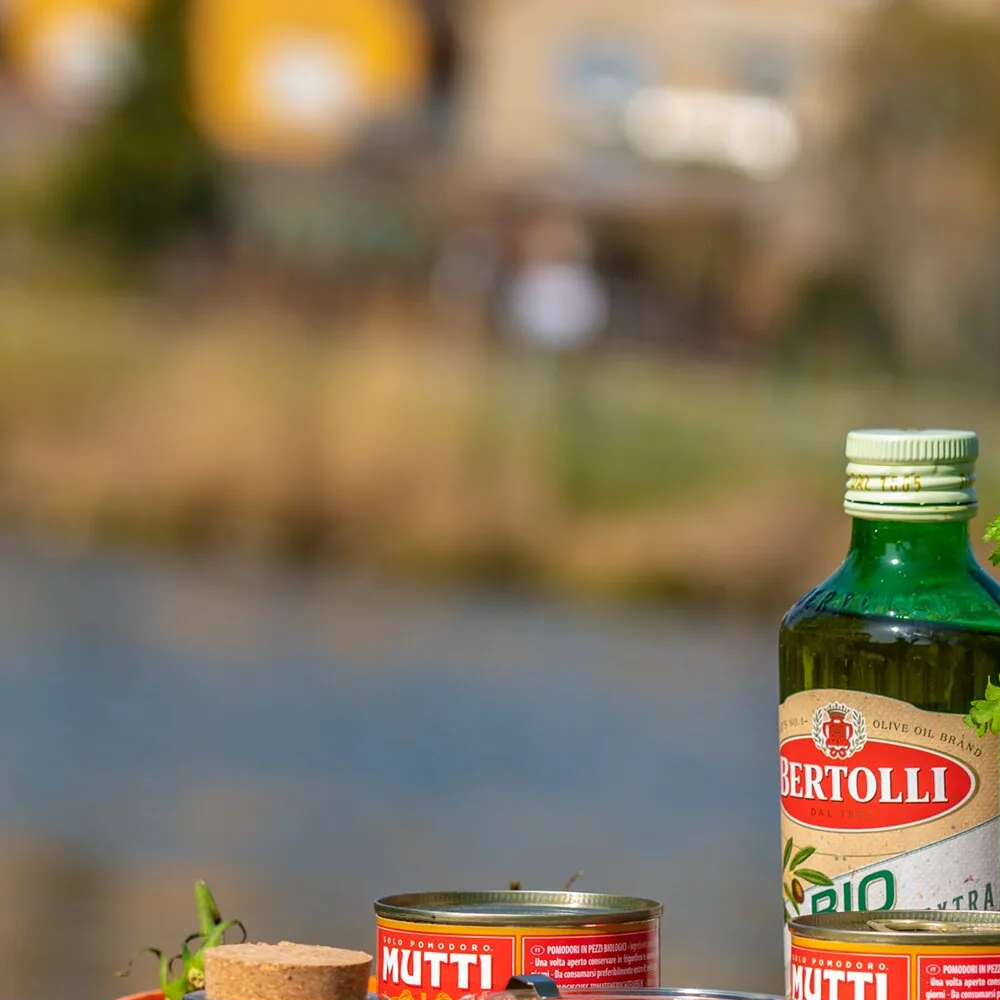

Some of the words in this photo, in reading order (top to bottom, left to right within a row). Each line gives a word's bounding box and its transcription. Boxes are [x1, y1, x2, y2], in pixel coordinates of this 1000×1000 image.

[873, 719, 908, 733] OLIVE
[914, 726, 934, 738] OIL
[940, 732, 983, 758] BRAND
[780, 756, 948, 804] BERTOLLI
[925, 883, 994, 911] TRA
[383, 936, 402, 945] SOLO
[547, 945, 580, 954] POMODORI
[581, 945, 587, 953] IN
[588, 945, 603, 953] PEZZI
[535, 958, 548, 966] Una
[550, 958, 565, 966] volta
[567, 958, 587, 967] aperto
[588, 956, 616, 965] conservare
[382, 946, 492, 989] MUTTI
[555, 970, 562, 978] Da
[564, 968, 596, 978] consumarsi
[943, 964, 978, 974] POMODORI
[979, 965, 986, 973] IN
[930, 978, 943, 987] Una
[945, 977, 962, 986] volta
[964, 978, 985, 988] aperto
[926, 991, 945, 1000] giorni
[951, 990, 959, 998] Da
[961, 988, 996, 998] consumarsi
